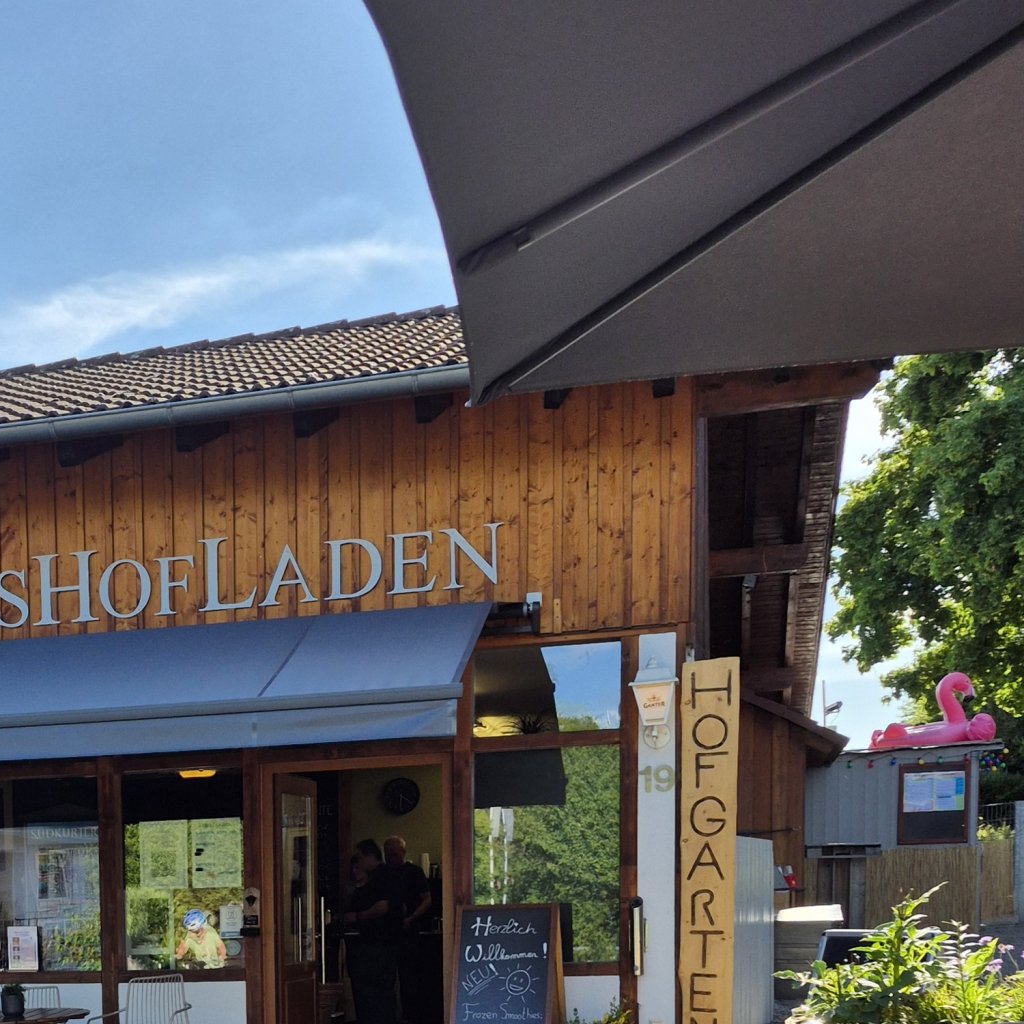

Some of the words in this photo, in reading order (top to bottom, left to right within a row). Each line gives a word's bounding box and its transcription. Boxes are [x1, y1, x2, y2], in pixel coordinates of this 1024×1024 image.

[639, 764, 675, 793] 19
[471, 915, 537, 937] Herzlich
[462, 1002, 498, 1021] Frozen
